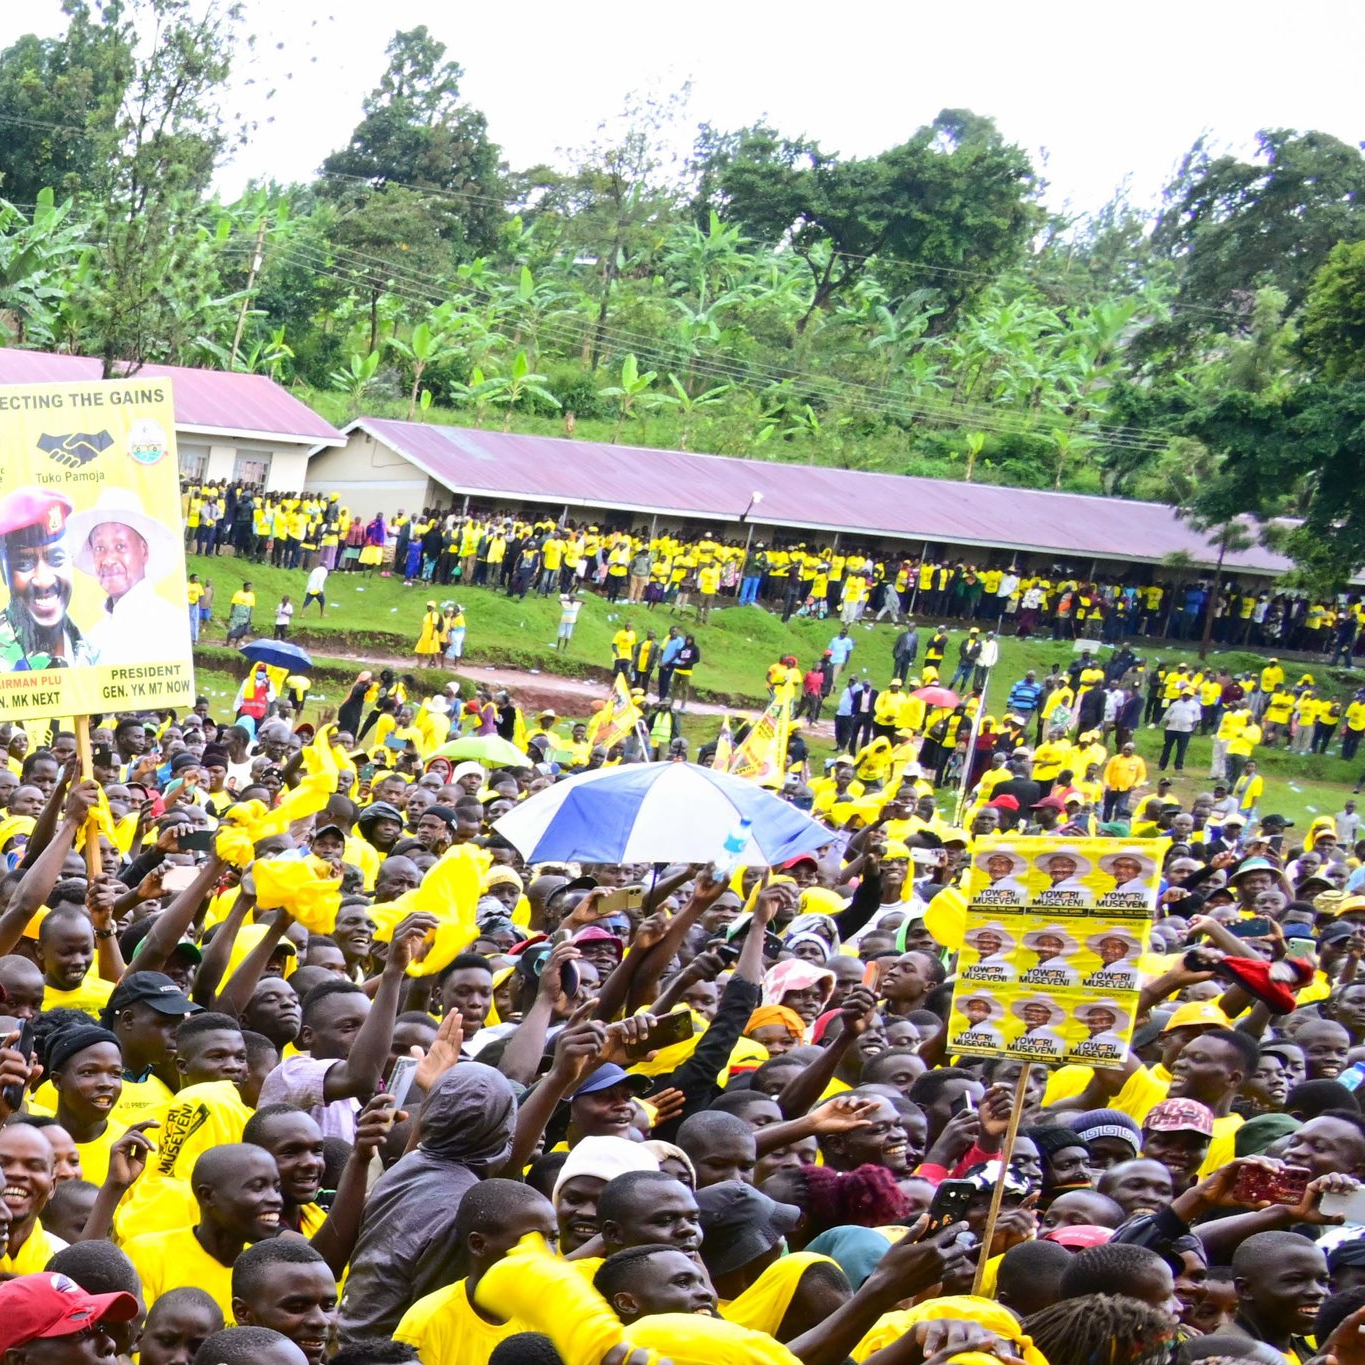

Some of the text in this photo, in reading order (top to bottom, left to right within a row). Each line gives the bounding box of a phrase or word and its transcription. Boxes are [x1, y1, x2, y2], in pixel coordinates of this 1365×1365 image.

[69, 392, 104, 407] THE
[110, 388, 165, 405] GAINS
[36, 470, 105, 484] Tuko Pamoja
[111, 665, 181, 680] PRESIDENT
[41, 675, 62, 686] PLU
[103, 680, 191, 699] GEN. YK M7 NOW
[12, 694, 29, 707] MK
[32, 691, 60, 706] NEXT
[973, 897, 1020, 905] MUSEVENI
[1032, 898, 1084, 907] MUSEVENI
[1096, 899, 1148, 908] MUSEVENI
[961, 972, 1007, 982] MUSEVENI
[1019, 975, 1070, 986] MUSEVENI
[1082, 979, 1135, 989] MUSEVENI
[953, 1038, 997, 1048] MUSEVENI
[1006, 1044, 1057, 1055] MUSEVENI
[1069, 1048, 1121, 1060] MUSEVENI
[157, 1103, 194, 1174] MUSEVENI
